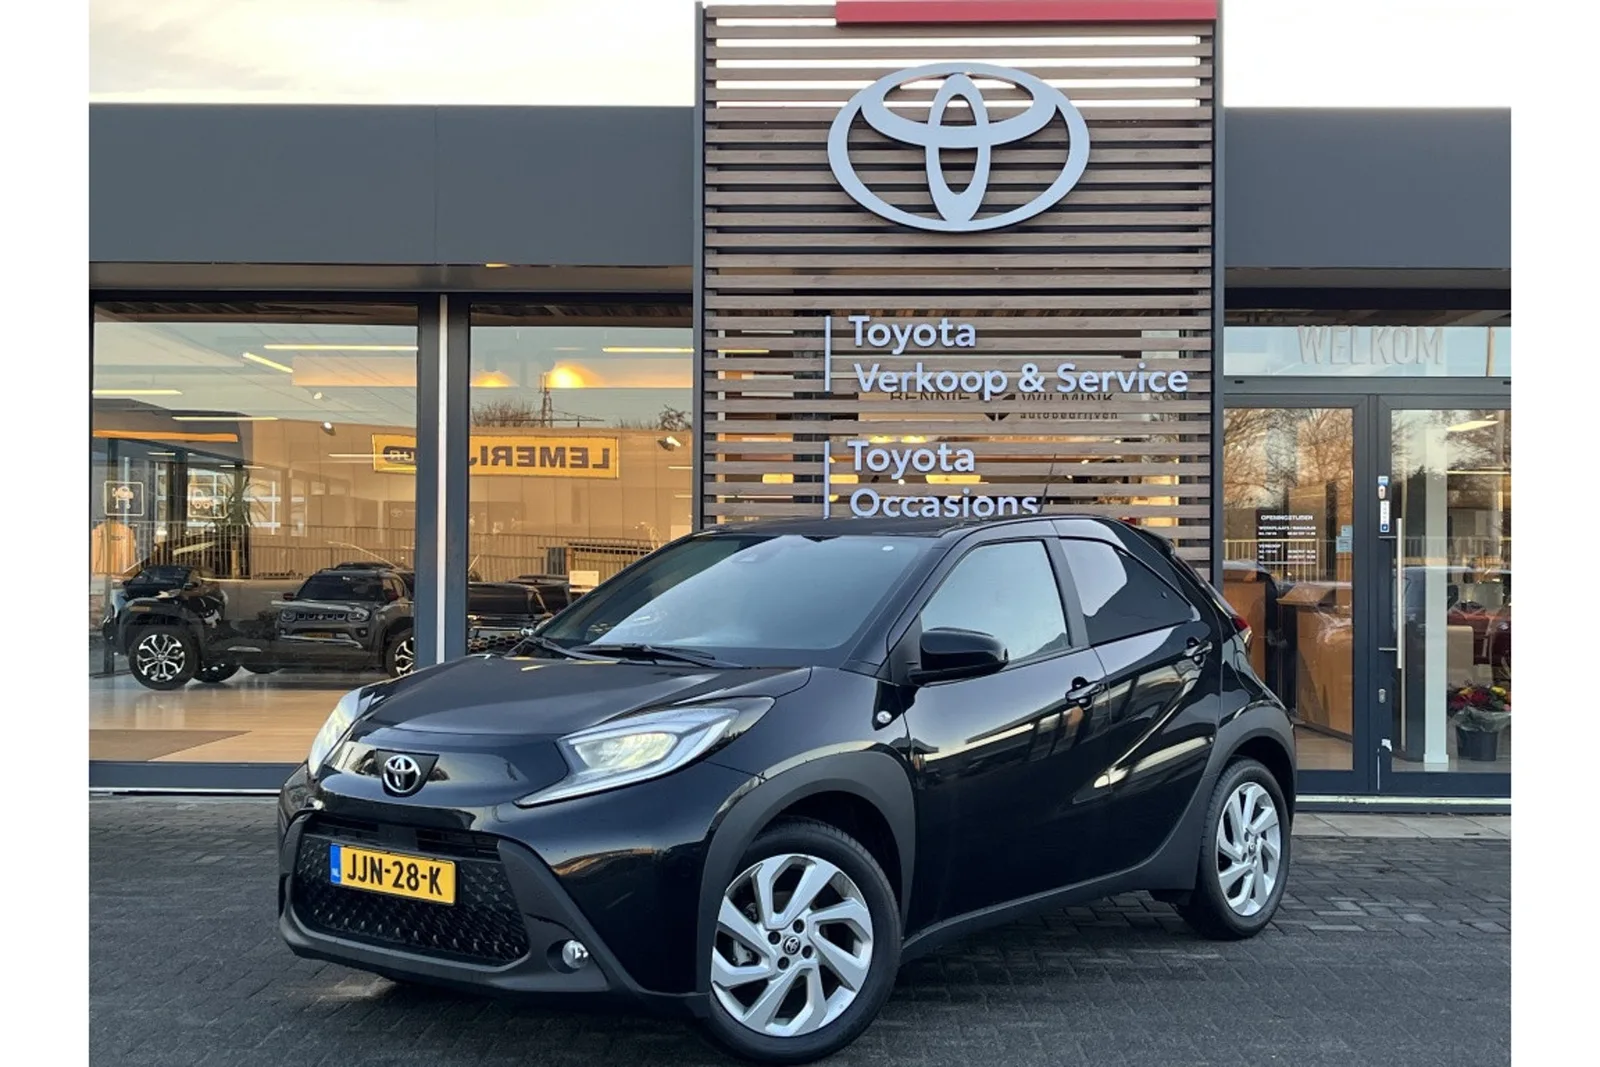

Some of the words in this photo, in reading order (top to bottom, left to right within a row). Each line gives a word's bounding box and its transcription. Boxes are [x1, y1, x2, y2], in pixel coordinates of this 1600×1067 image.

[848, 315, 976, 355] Toyota
[1296, 325, 1444, 365] WELKOM
[854, 362, 1008, 401] Verkoop
[1018, 363, 1048, 393] &
[1057, 362, 1189, 393] Service
[847, 440, 976, 480] Toyota
[850, 487, 1039, 518] Occasions
[347, 853, 443, 896] JJN-28-K
